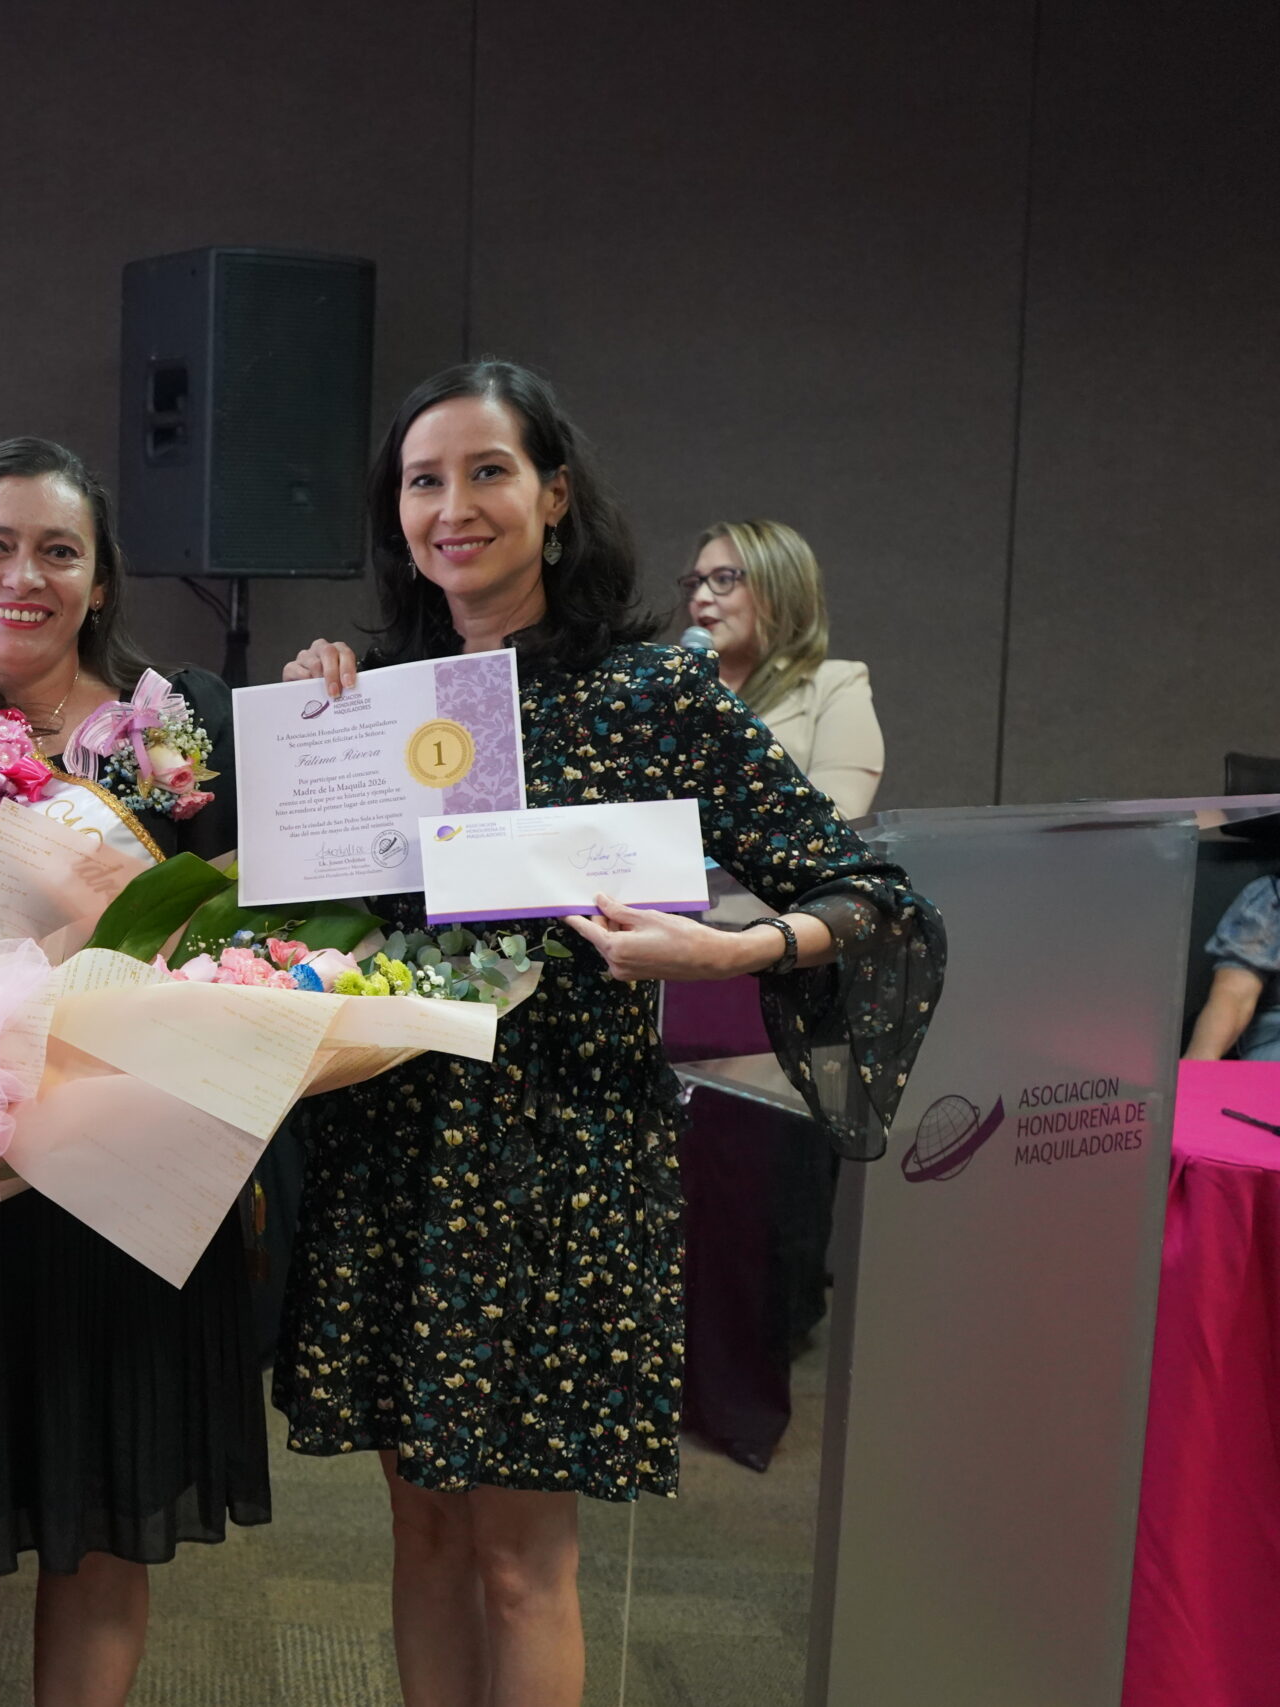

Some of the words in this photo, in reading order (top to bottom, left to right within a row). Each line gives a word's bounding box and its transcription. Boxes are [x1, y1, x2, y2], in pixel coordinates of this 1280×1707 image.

[339, 748, 380, 762] Rivera
[432, 740, 448, 767] 1
[293, 787, 316, 796] Madre
[318, 785, 327, 793] de
[328, 784, 334, 792] la
[336, 781, 366, 793] Maquila
[367, 778, 386, 787] 2026
[1019, 1077, 1119, 1109] ASOCIACION
[1017, 1102, 1120, 1138] HONDUREÑA
[1124, 1102, 1147, 1124] DE
[1015, 1130, 1143, 1167] MAQUILADORES
